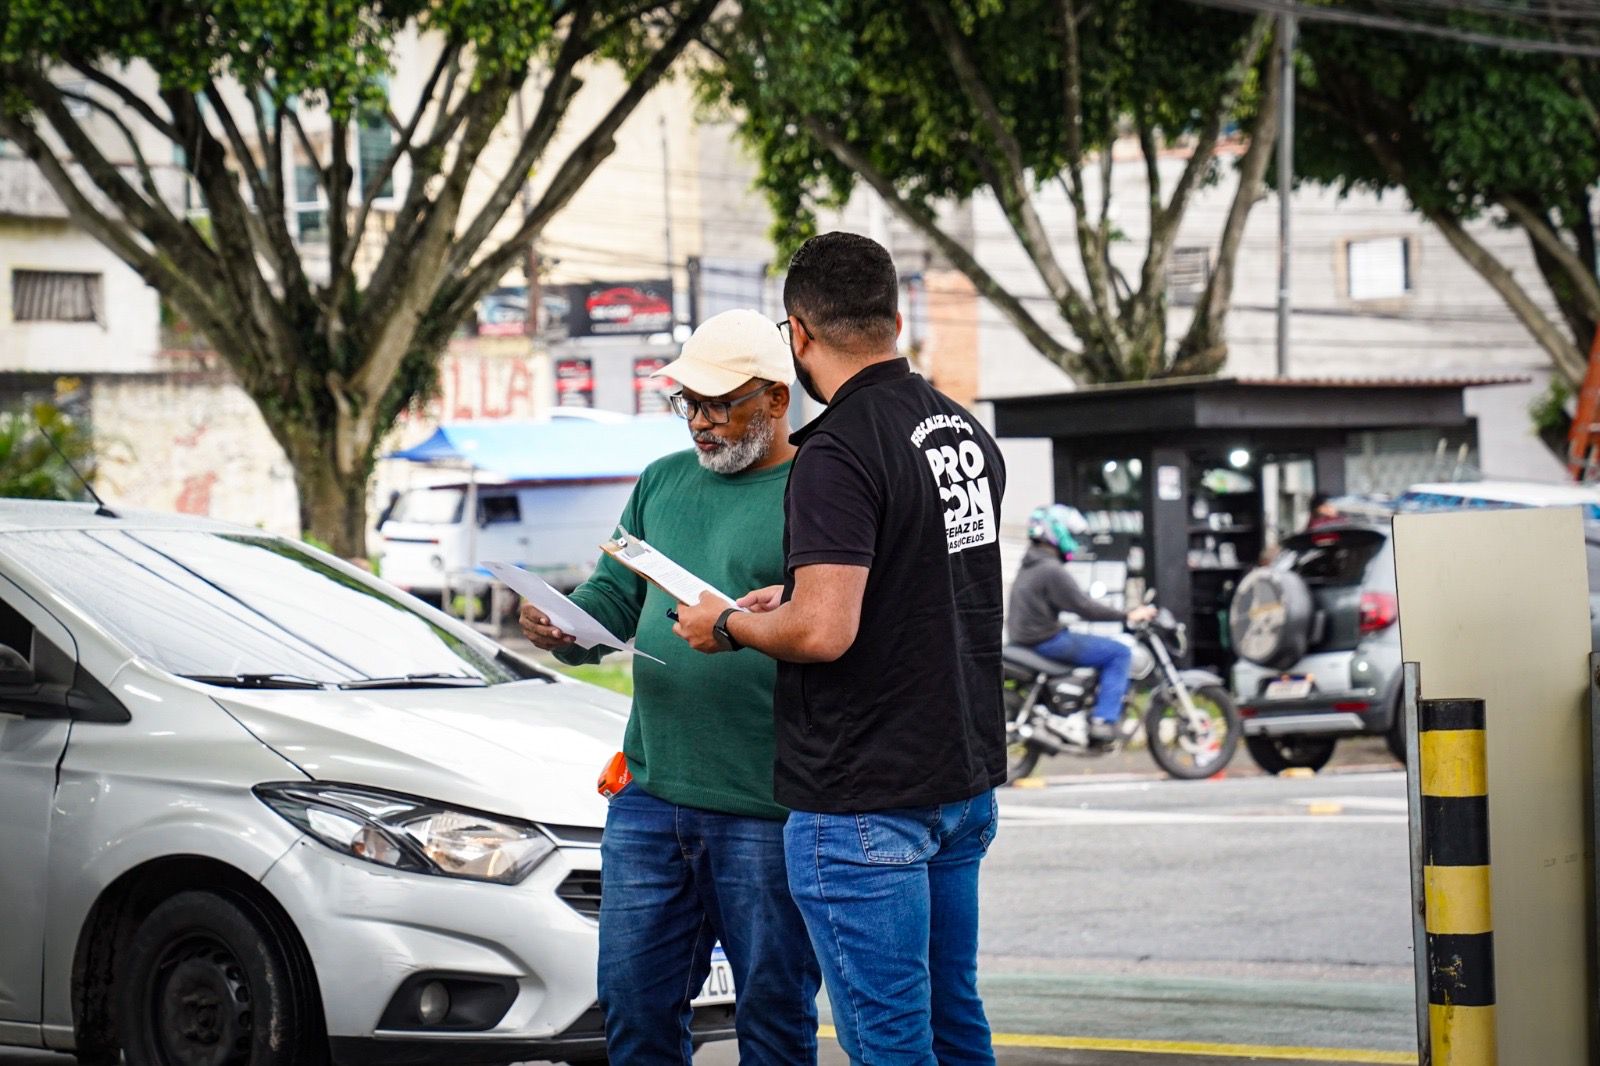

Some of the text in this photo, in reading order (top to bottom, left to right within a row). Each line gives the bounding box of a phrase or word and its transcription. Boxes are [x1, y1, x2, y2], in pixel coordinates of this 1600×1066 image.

[925, 440, 984, 487] PRO
[946, 519, 984, 538] FEAZ DE
